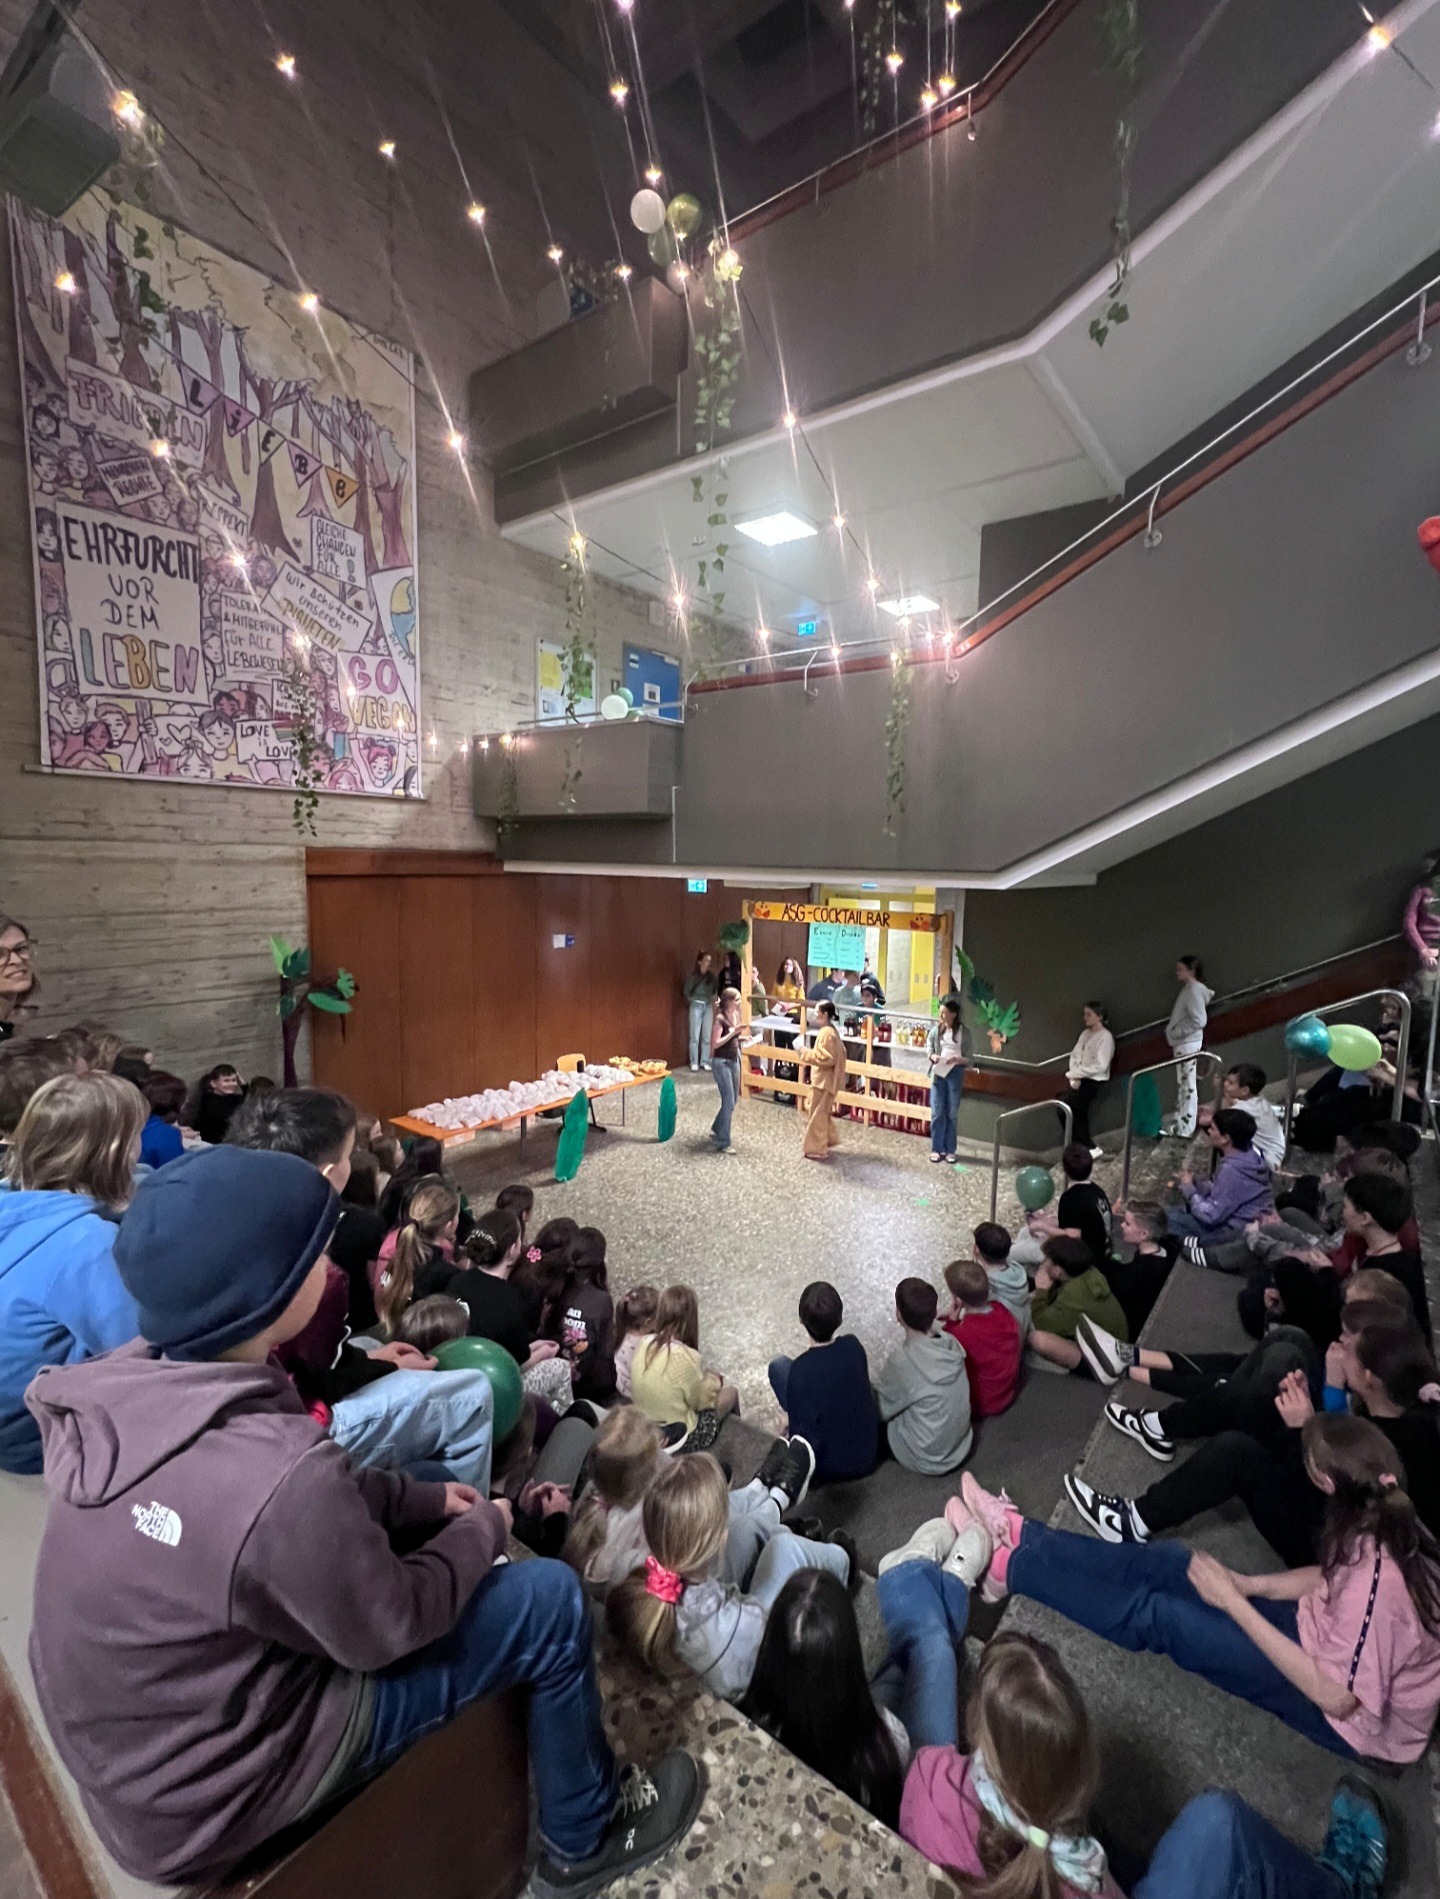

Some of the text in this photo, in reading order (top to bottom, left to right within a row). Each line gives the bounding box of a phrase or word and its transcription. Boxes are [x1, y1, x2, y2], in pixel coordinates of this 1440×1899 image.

[69, 371, 203, 451] FRIEDN
[62, 516, 199, 584] EHRFURCHT
[108, 573, 159, 605] VOR
[101, 599, 160, 630] DEM
[80, 628, 199, 694] LEBEN
[348, 655, 399, 694] GO
[347, 695, 416, 733] VEGAN
[241, 724, 269, 738] LOVE
[131, 1504, 165, 1528] NORTH
[150, 1501, 170, 1519] THE
[135, 1518, 160, 1540] FACE
